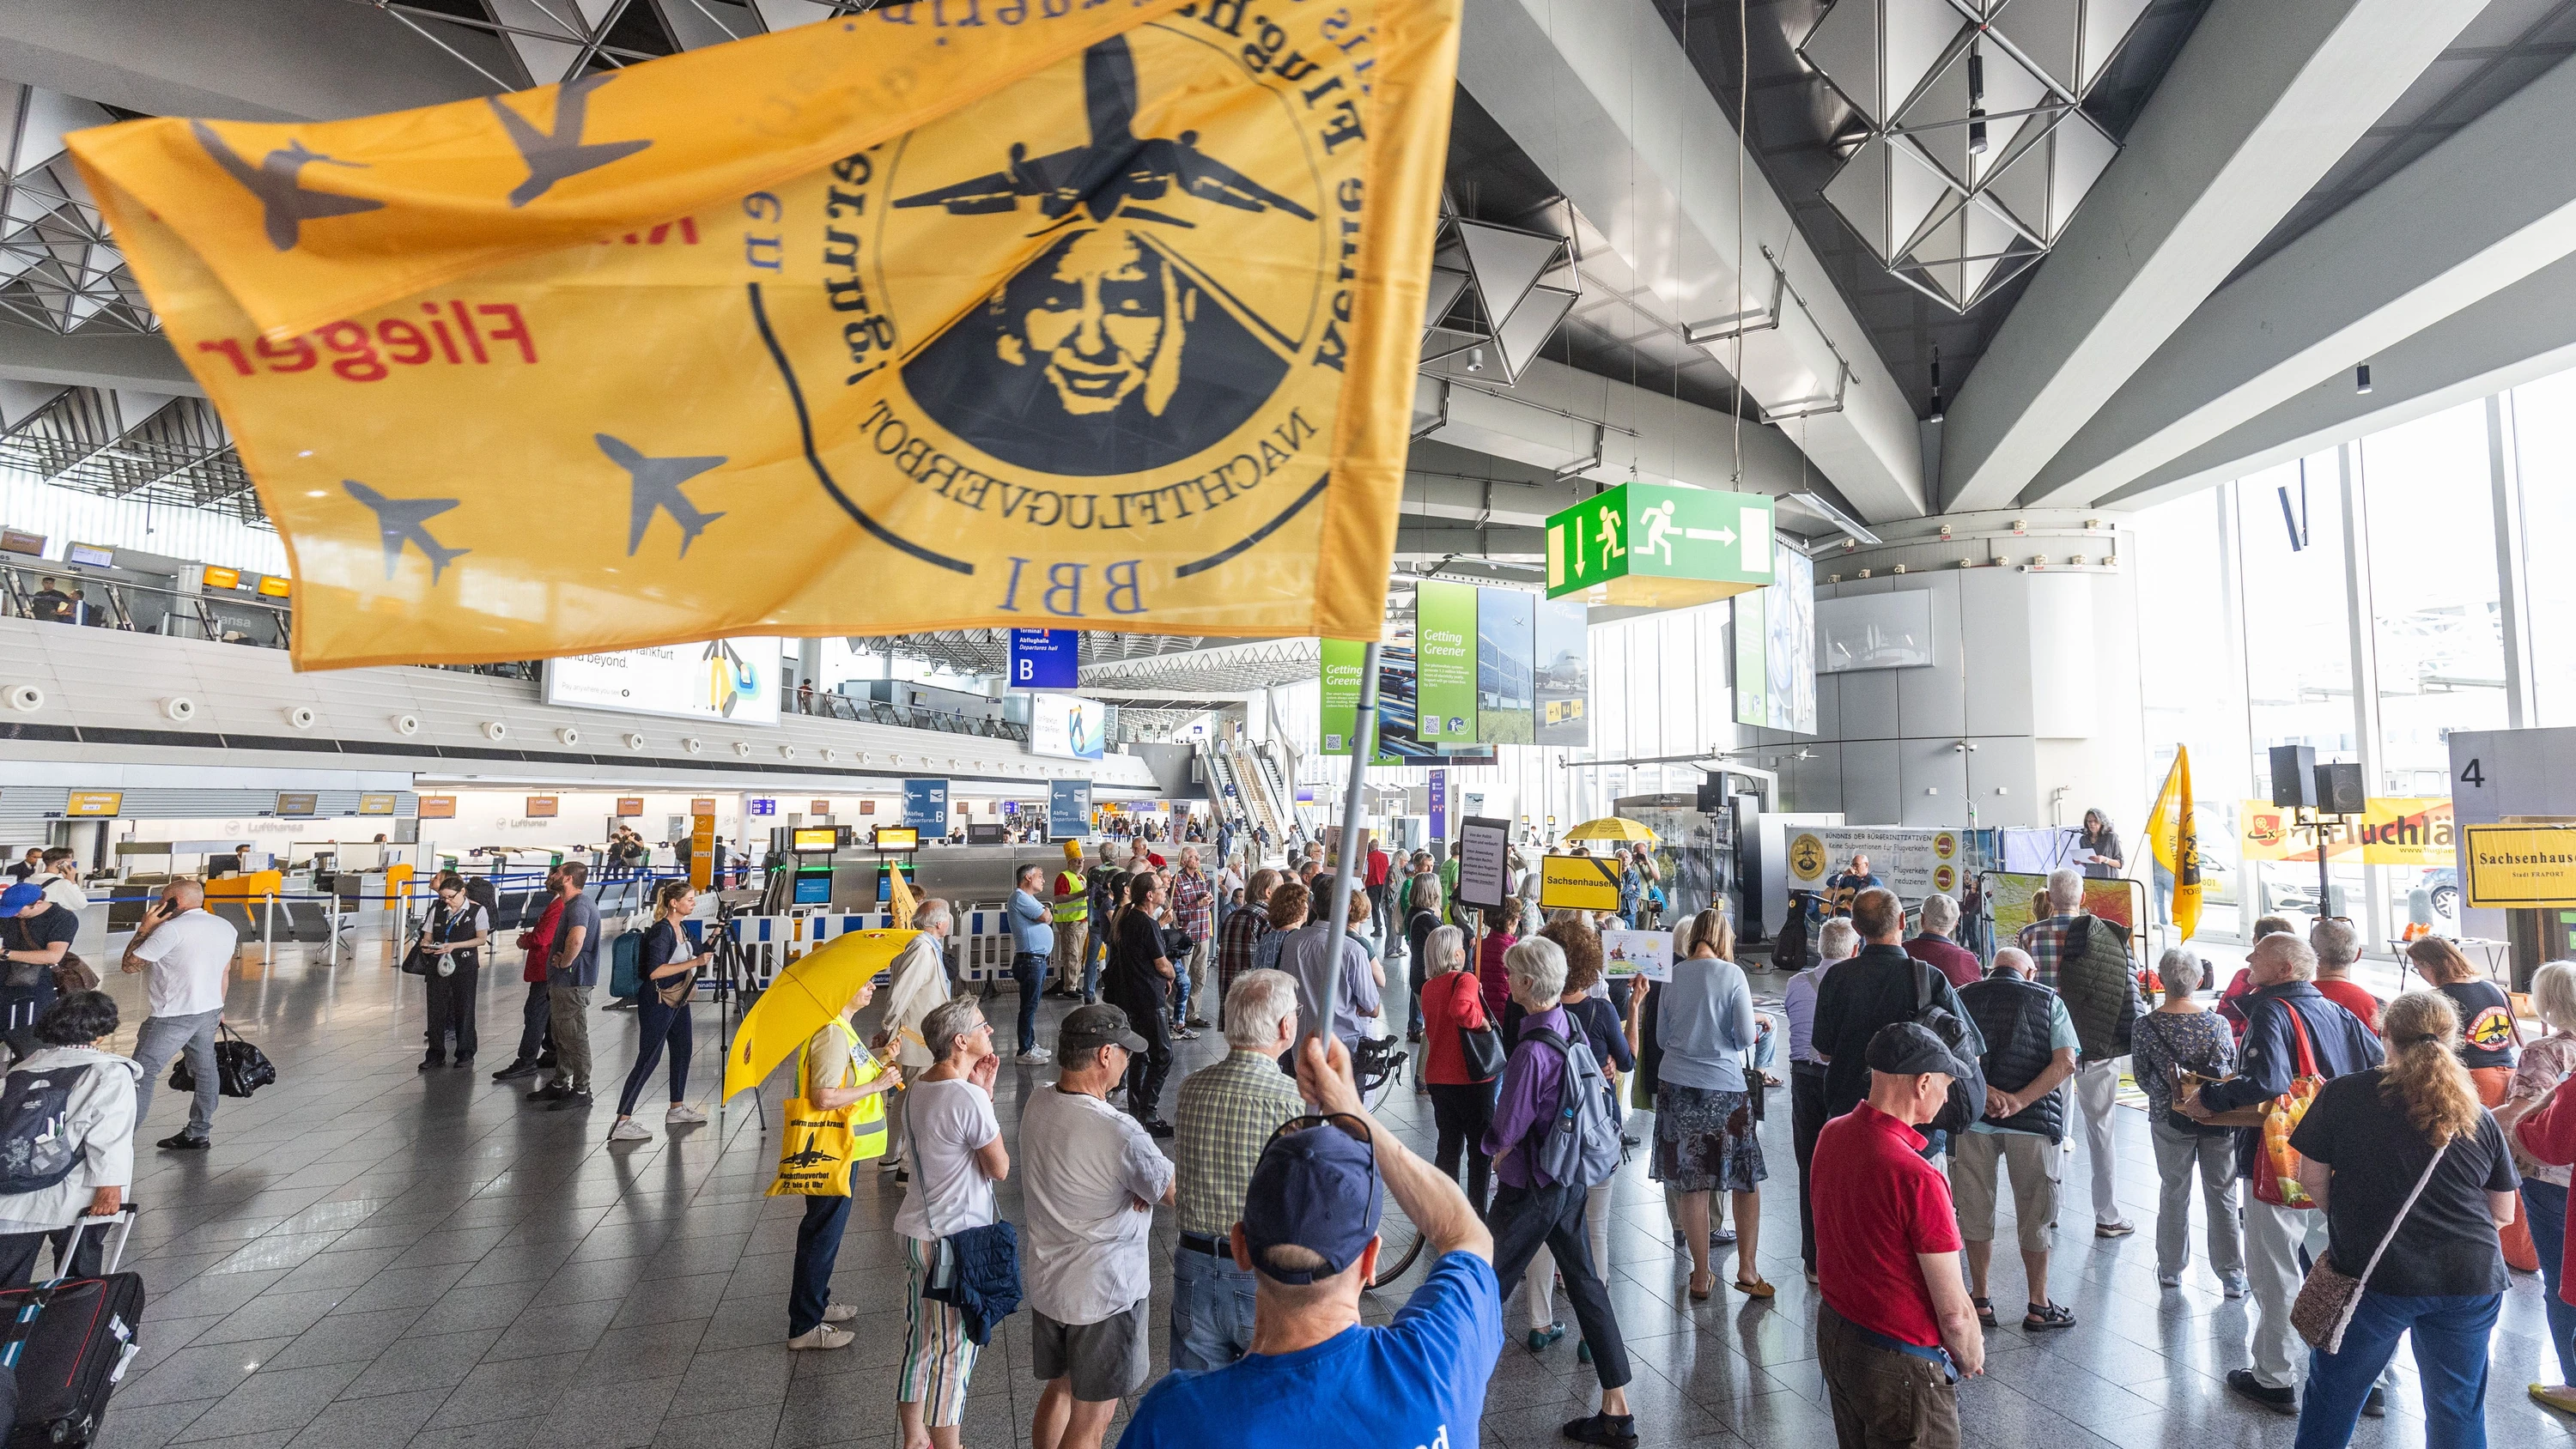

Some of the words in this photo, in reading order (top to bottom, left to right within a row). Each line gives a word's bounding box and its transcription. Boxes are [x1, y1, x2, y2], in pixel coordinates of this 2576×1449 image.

[1424, 628, 1462, 646] Getting
[1424, 643, 1467, 657] Greener
[587, 652, 629, 669] beyond.
[1019, 658, 1034, 680] B
[1326, 664, 1364, 677] Getting
[1326, 676, 1363, 686] Greene
[2461, 758, 2485, 788] 4
[935, 810, 945, 822] B
[1079, 810, 1087, 822] B
[247, 822, 304, 834] Lufthansa
[511, 819, 547, 828] Lufthansa
[1867, 832, 1932, 842] BÜRGERINITIATIVEN
[1844, 842, 1881, 851] Subventionen
[1893, 843, 1929, 852] Flugverkehr
[1893, 865, 1929, 876] Flugverkehr
[1546, 876, 1614, 888] Sachsenhausen
[2468, 1012, 2488, 1036] Stopp
[780, 1171, 829, 1179] Nachtflugverbot
